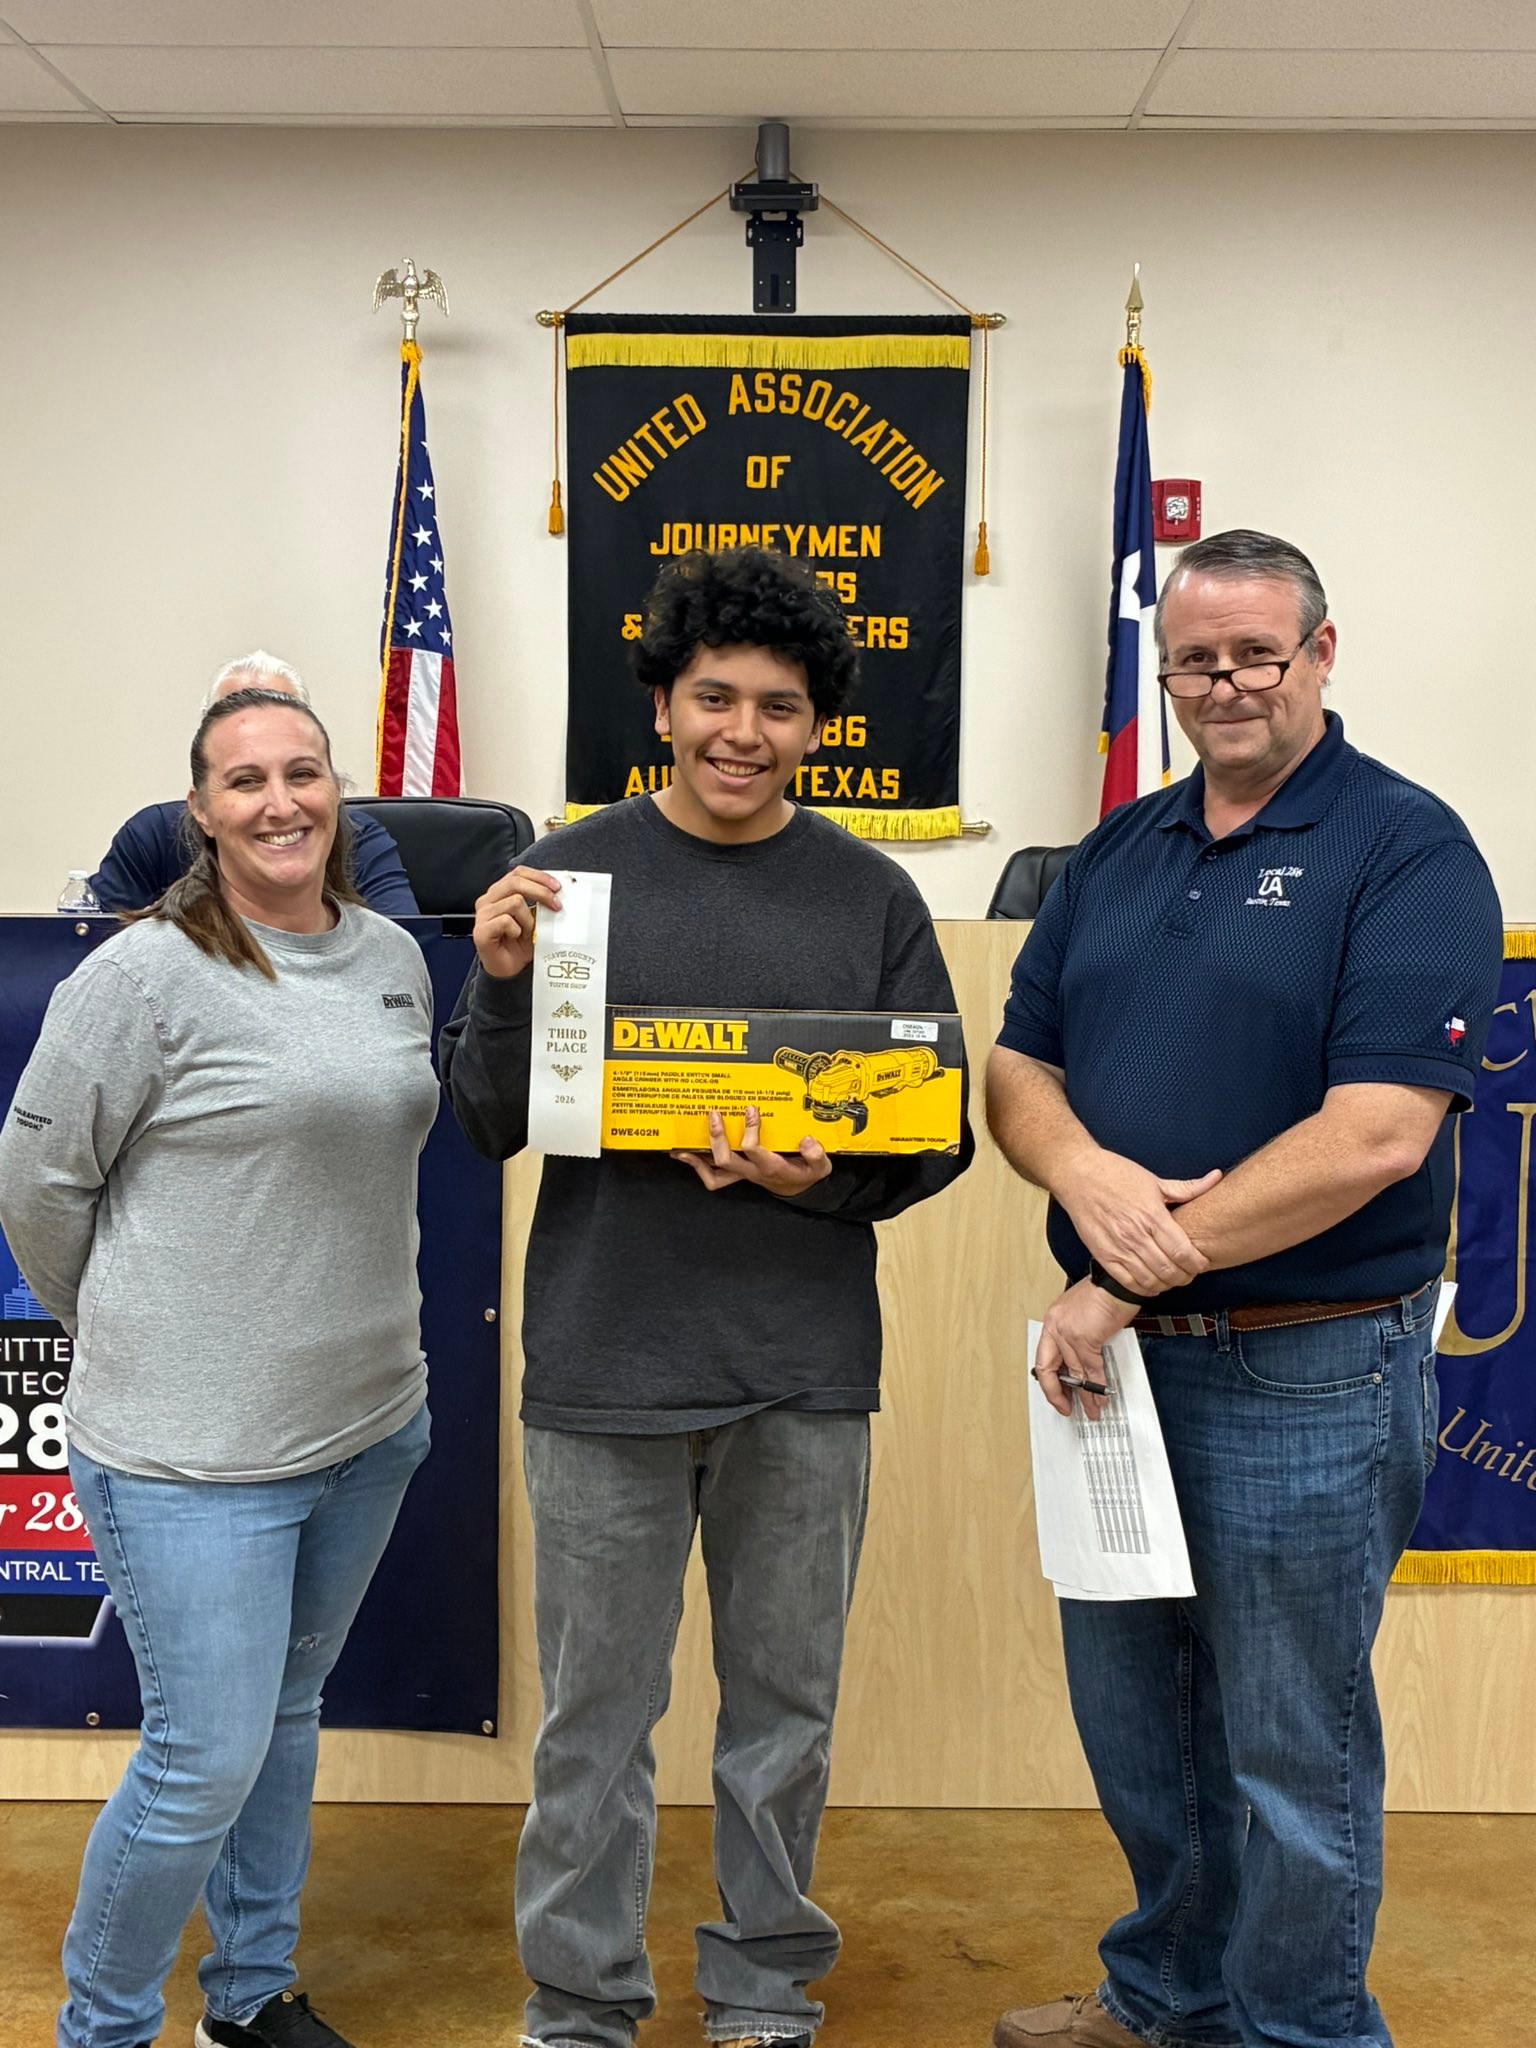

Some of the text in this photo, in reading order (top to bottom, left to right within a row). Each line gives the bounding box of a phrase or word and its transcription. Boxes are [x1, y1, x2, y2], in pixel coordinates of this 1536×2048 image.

[592, 372, 945, 510] UNITED ASSOCIATION
[746, 455, 791, 489] OF
[650, 522, 881, 557] JOURNEYMEN
[822, 715, 867, 748] 86
[795, 765, 900, 800] TEXAS
[1258, 876, 1283, 897] UA
[546, 1041, 588, 1053] PLACE
[548, 1028, 587, 1039] THIRD
[555, 1095, 576, 1104] 2026
[611, 1128, 659, 1136] DWE402N
